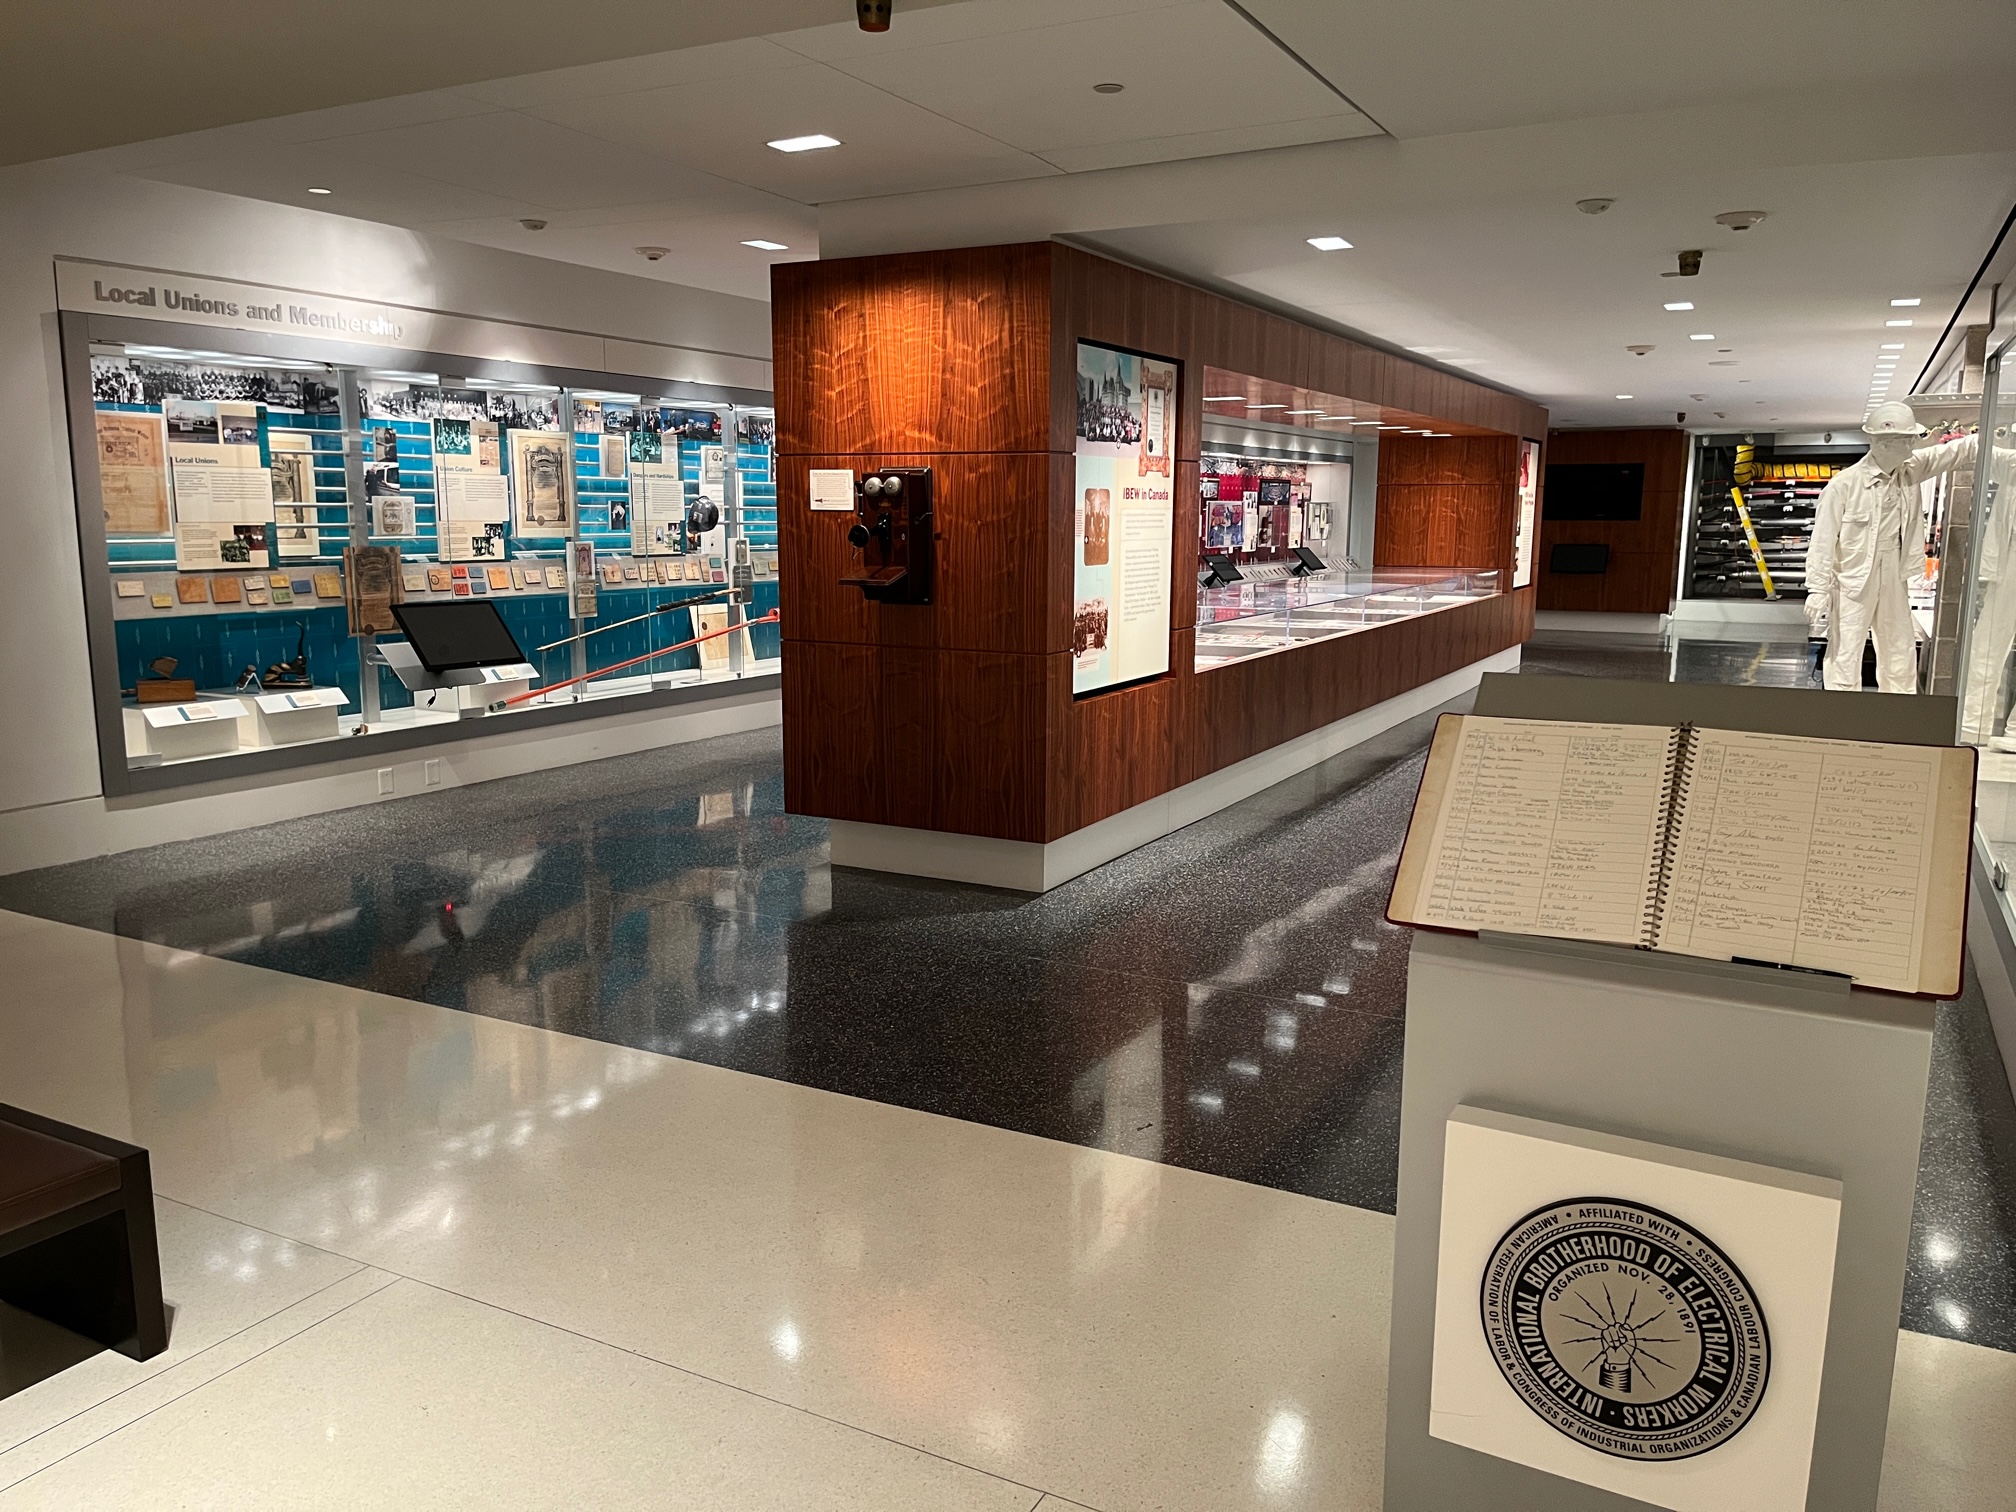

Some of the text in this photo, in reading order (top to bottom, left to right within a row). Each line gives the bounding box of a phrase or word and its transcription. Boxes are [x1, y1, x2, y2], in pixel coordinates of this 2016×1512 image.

[94, 280, 404, 340] Local Unions and Membership
[195, 457, 218, 465] Unions
[1123, 487, 1169, 500] IBEW in Canada
[1579, 1208, 1680, 1241] AFFILIATED WITH
[1548, 1262, 1696, 1333] ORGANIZED NOV. 28, 1891
[1488, 1214, 1761, 1454] AMERICAN FEDERATION OF LABOR & CONGRESS OF INDUSTRIAL ORGANIZATIONS & CANADIAN LABOUR CONGRESS
[1516, 1235, 1729, 1427] INTERNATIONAL BROTHERHOOD OF ELECTRICAL WORKERS
